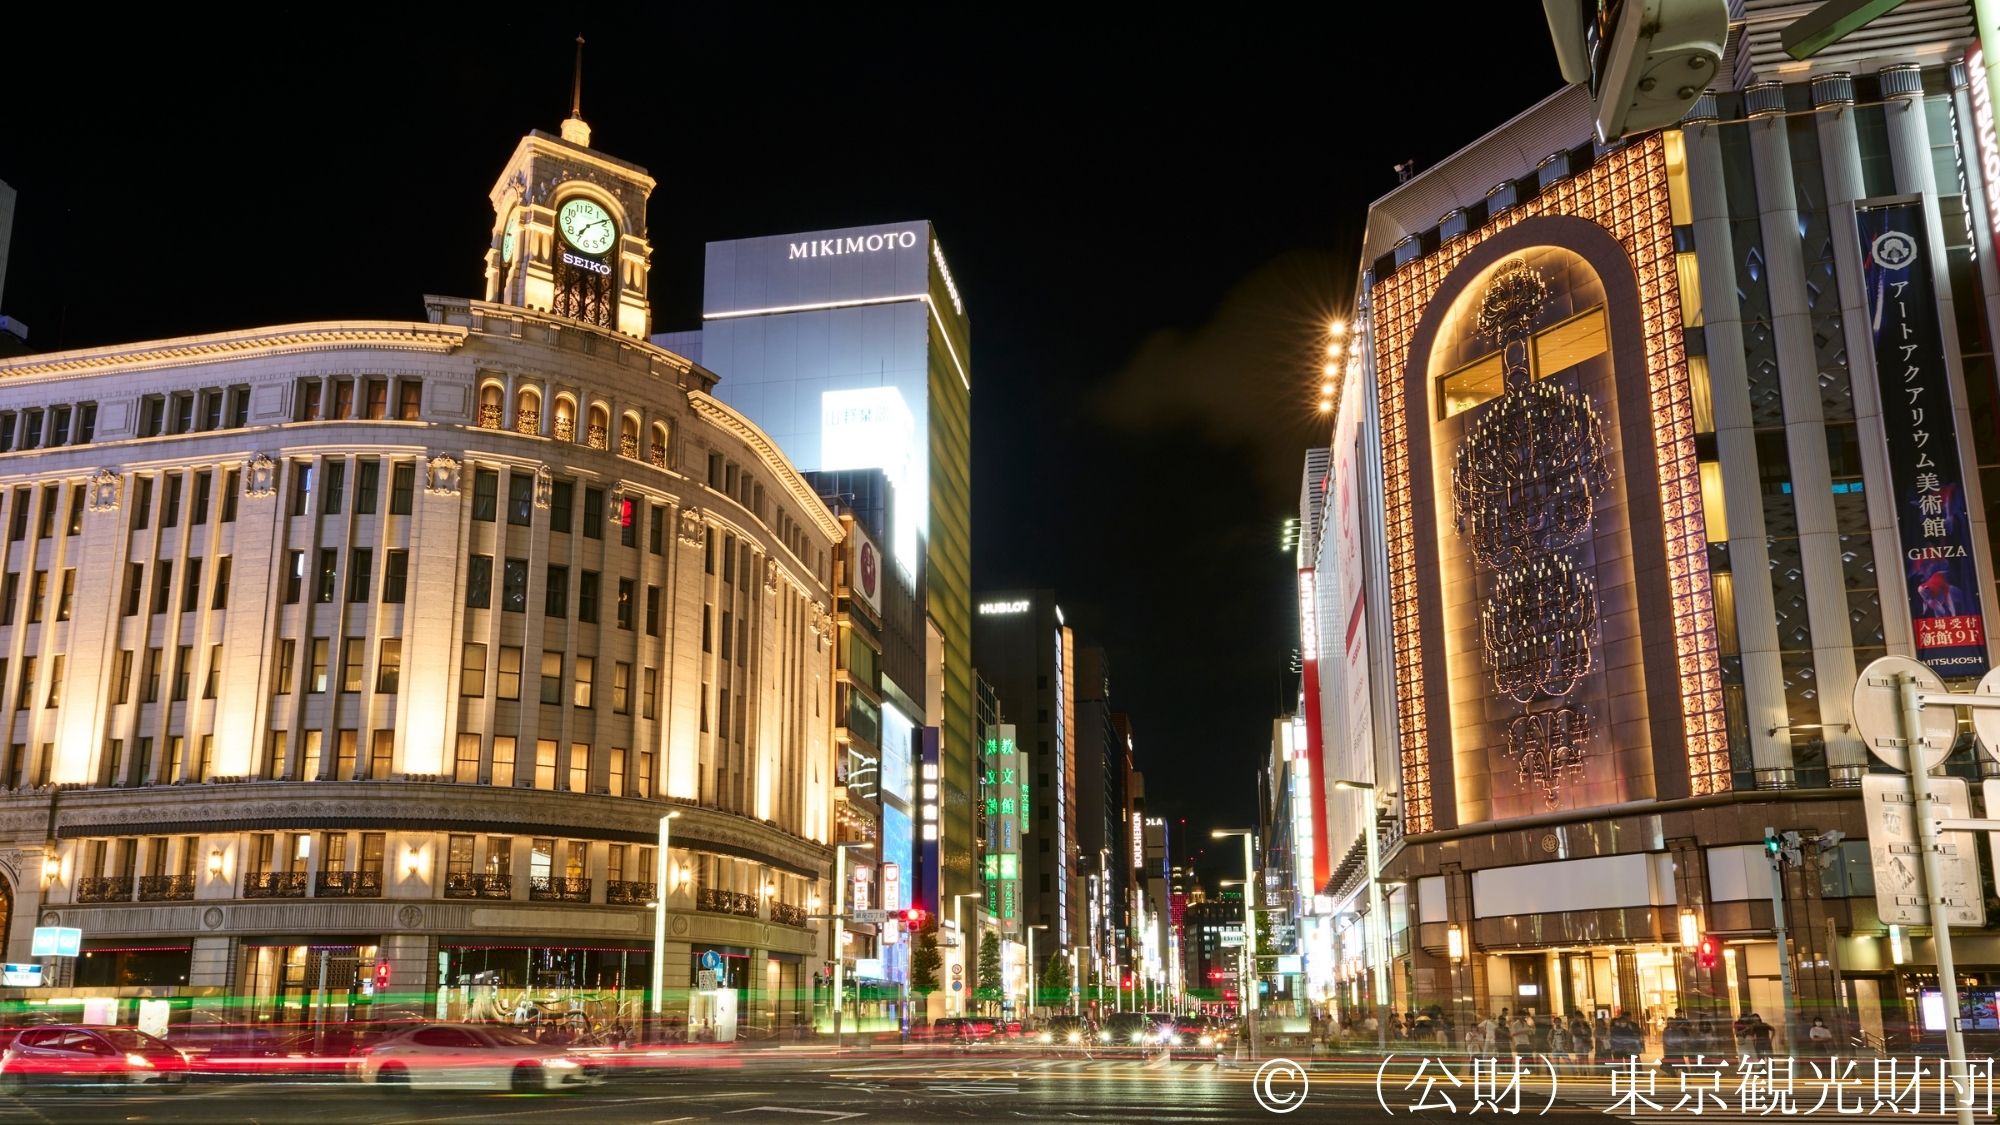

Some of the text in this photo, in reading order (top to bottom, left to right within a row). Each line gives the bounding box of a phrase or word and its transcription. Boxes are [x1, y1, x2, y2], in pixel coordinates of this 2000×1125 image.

[789, 231, 917, 260] MIKIMOTO
[563, 253, 612, 275] SEIKO
[1889, 280, 1947, 538] アートアクアリウム美術館
[1908, 545, 1968, 562] GINZA
[980, 602, 1029, 614] HUBLOT
[1920, 617, 1977, 631] 入場受付
[1920, 630, 1980, 647] 新館9F
[1000, 738, 1015, 815] 教文館
